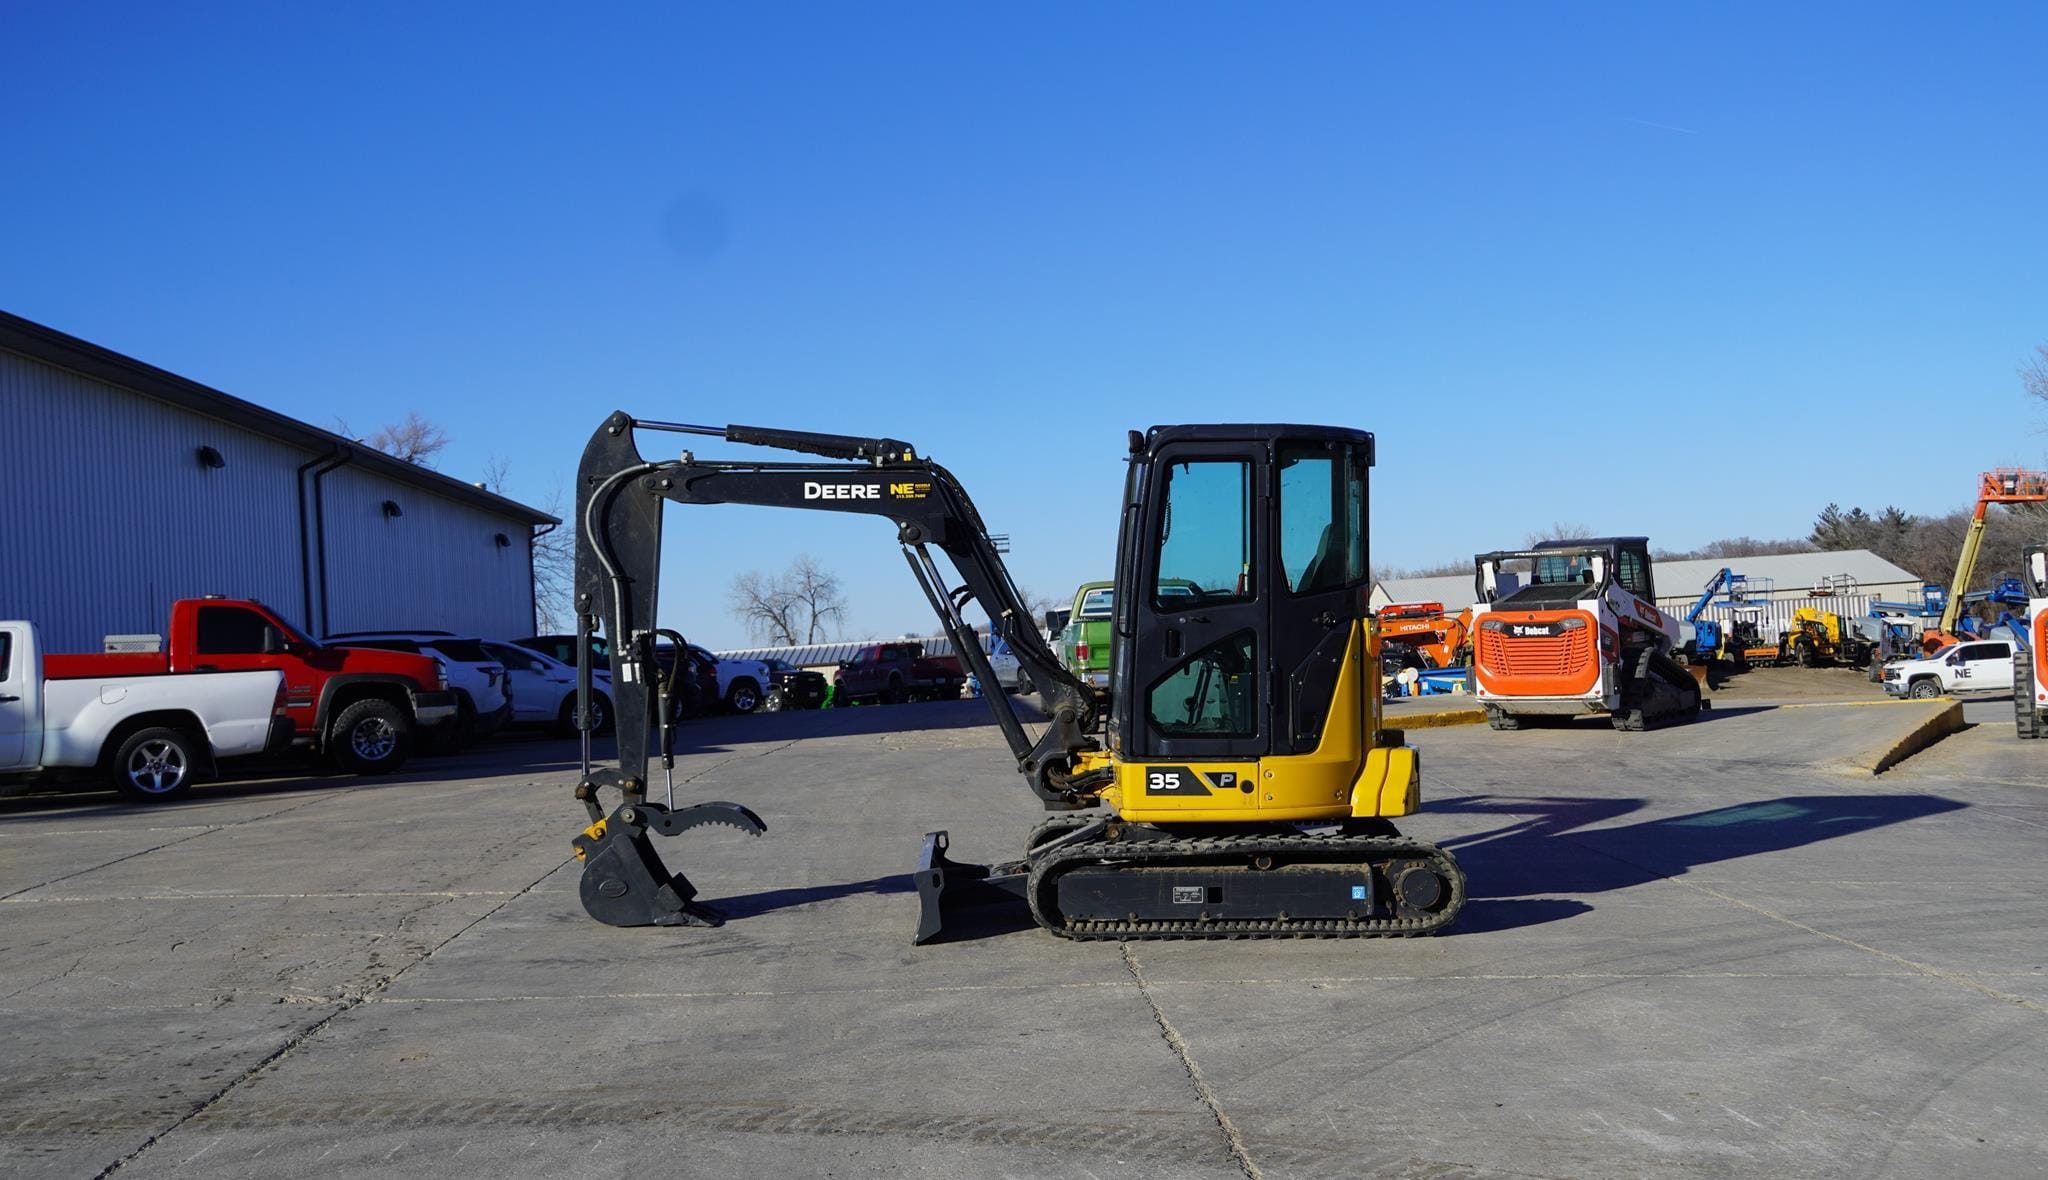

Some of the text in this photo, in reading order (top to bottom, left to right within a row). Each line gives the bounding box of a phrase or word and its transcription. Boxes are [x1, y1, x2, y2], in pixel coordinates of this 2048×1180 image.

[804, 482, 881, 499] DEERE
[890, 483, 915, 494] NE
[1525, 626, 1550, 635] Bobcat
[1954, 668, 1972, 679] NE
[1149, 773, 1180, 790] 35
[1220, 774, 1234, 787] P
